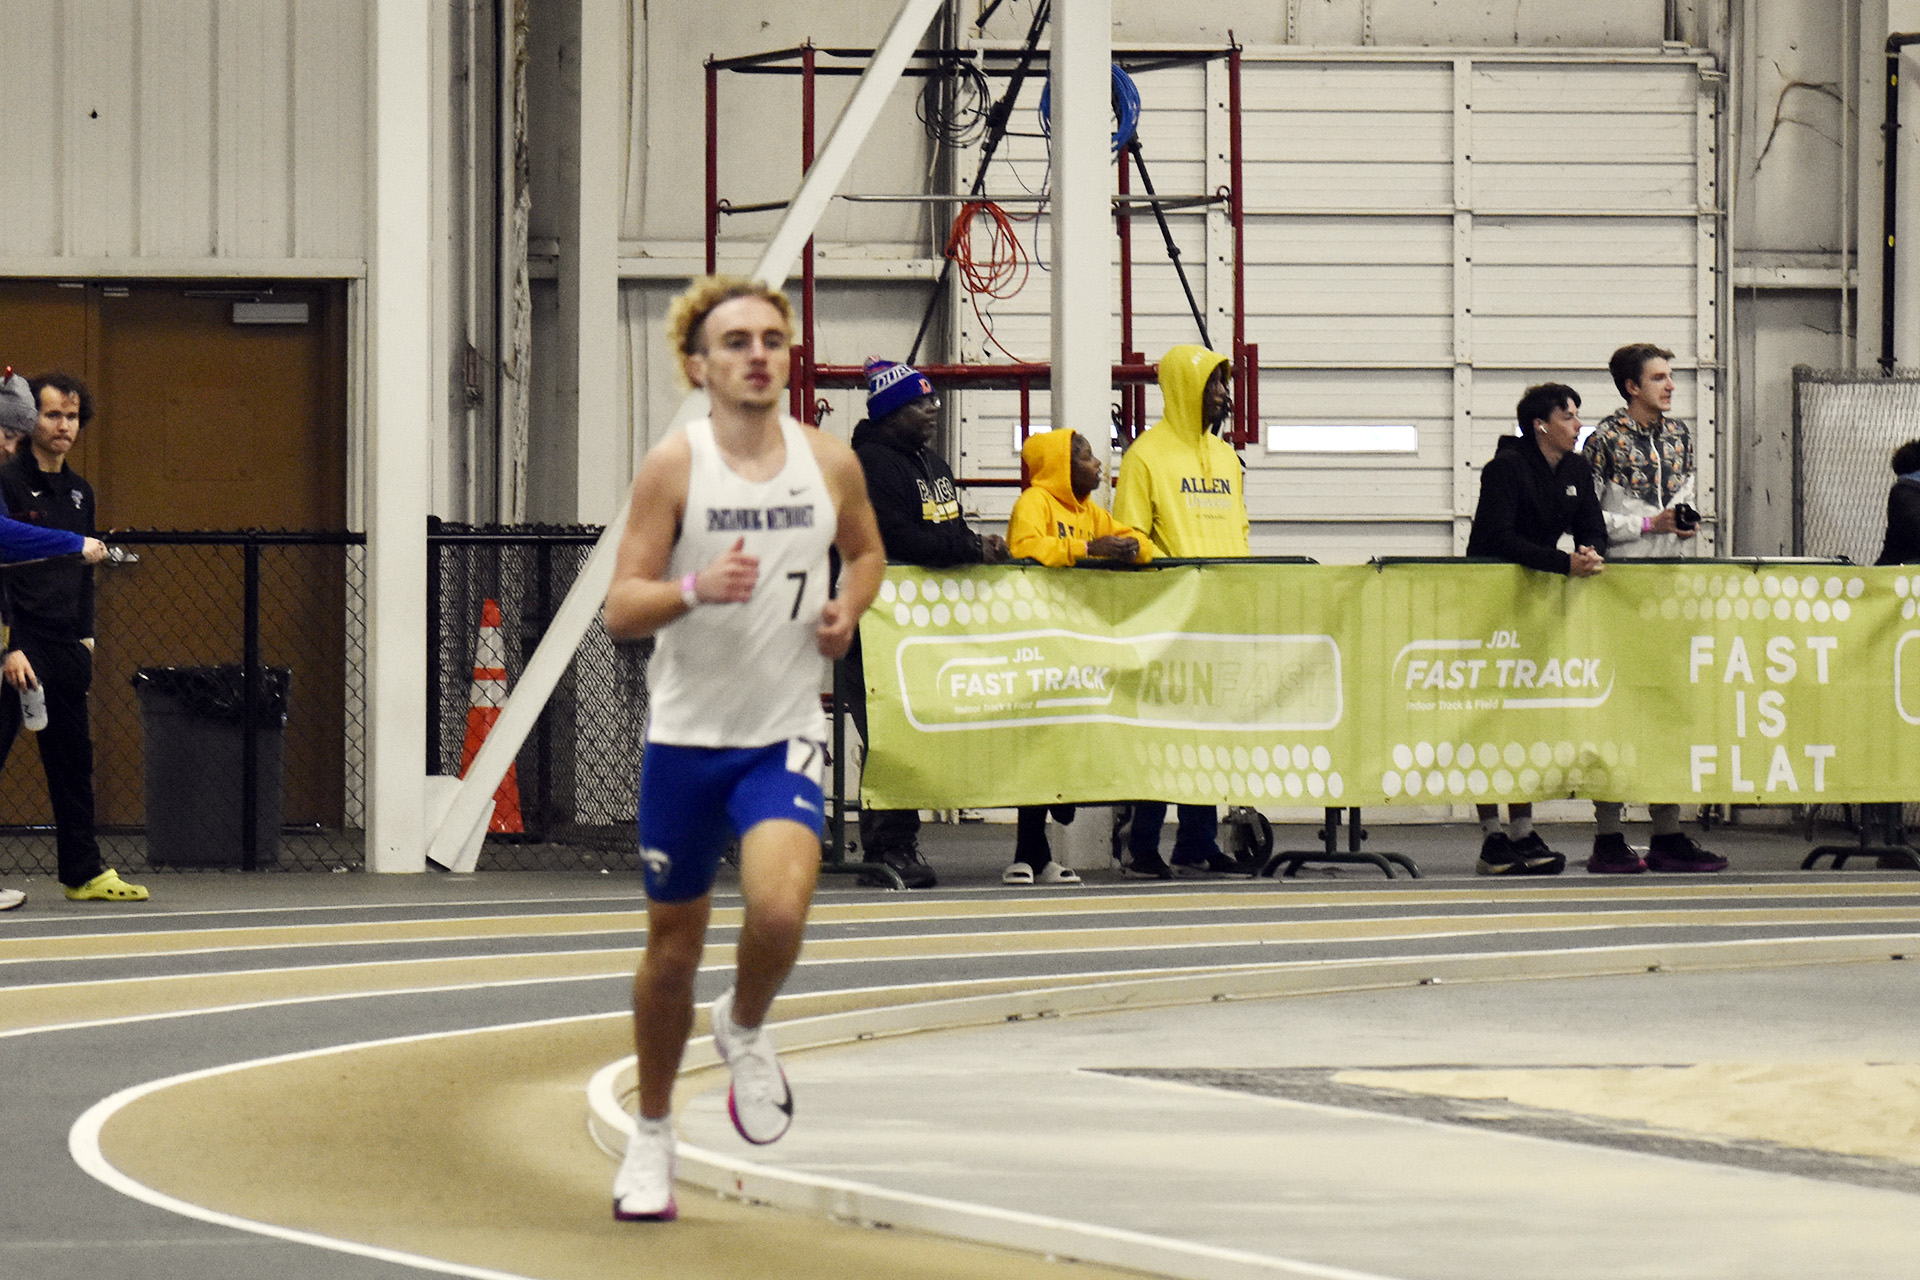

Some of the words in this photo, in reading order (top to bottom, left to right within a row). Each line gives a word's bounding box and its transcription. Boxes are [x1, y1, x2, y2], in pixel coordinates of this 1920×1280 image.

[1180, 477, 1231, 494] ALLEN
[787, 571, 807, 620] 7
[1012, 646, 1045, 663] JDL
[1486, 631, 1520, 649] JDL
[1405, 659, 1487, 690] FAST
[1496, 658, 1600, 688] TRACK
[1690, 635, 1838, 684] FAST
[951, 671, 1018, 697] FAST
[1026, 665, 1110, 692] TRACK
[1736, 690, 1786, 738] IS
[1690, 745, 1836, 792] FLAT
